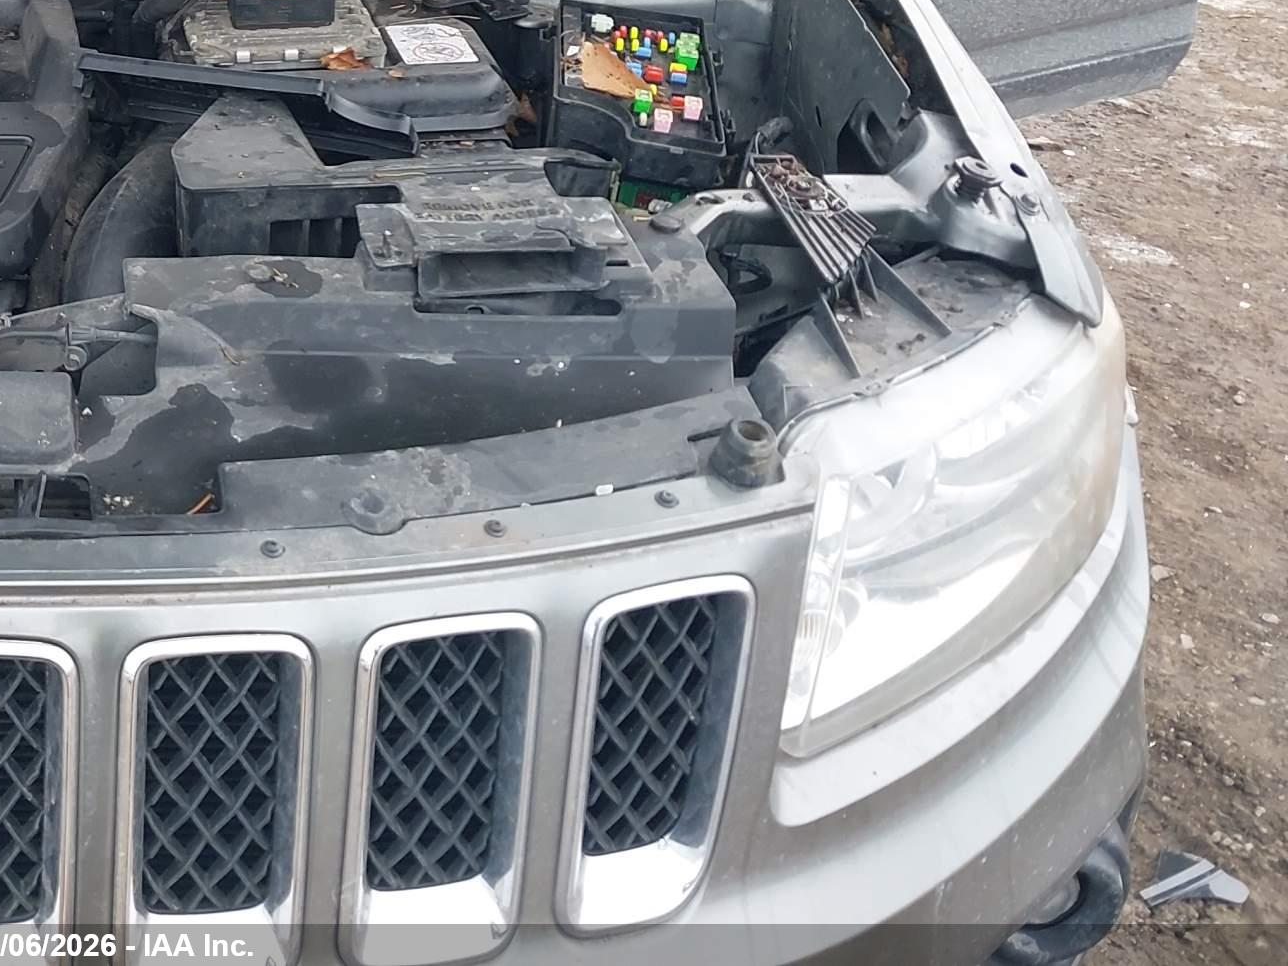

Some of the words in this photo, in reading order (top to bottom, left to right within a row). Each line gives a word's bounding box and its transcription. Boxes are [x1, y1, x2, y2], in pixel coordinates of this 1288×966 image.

[423, 201, 491, 211] REMOVE
[496, 198, 534, 209] FOR
[492, 208, 559, 221] ACCESS
